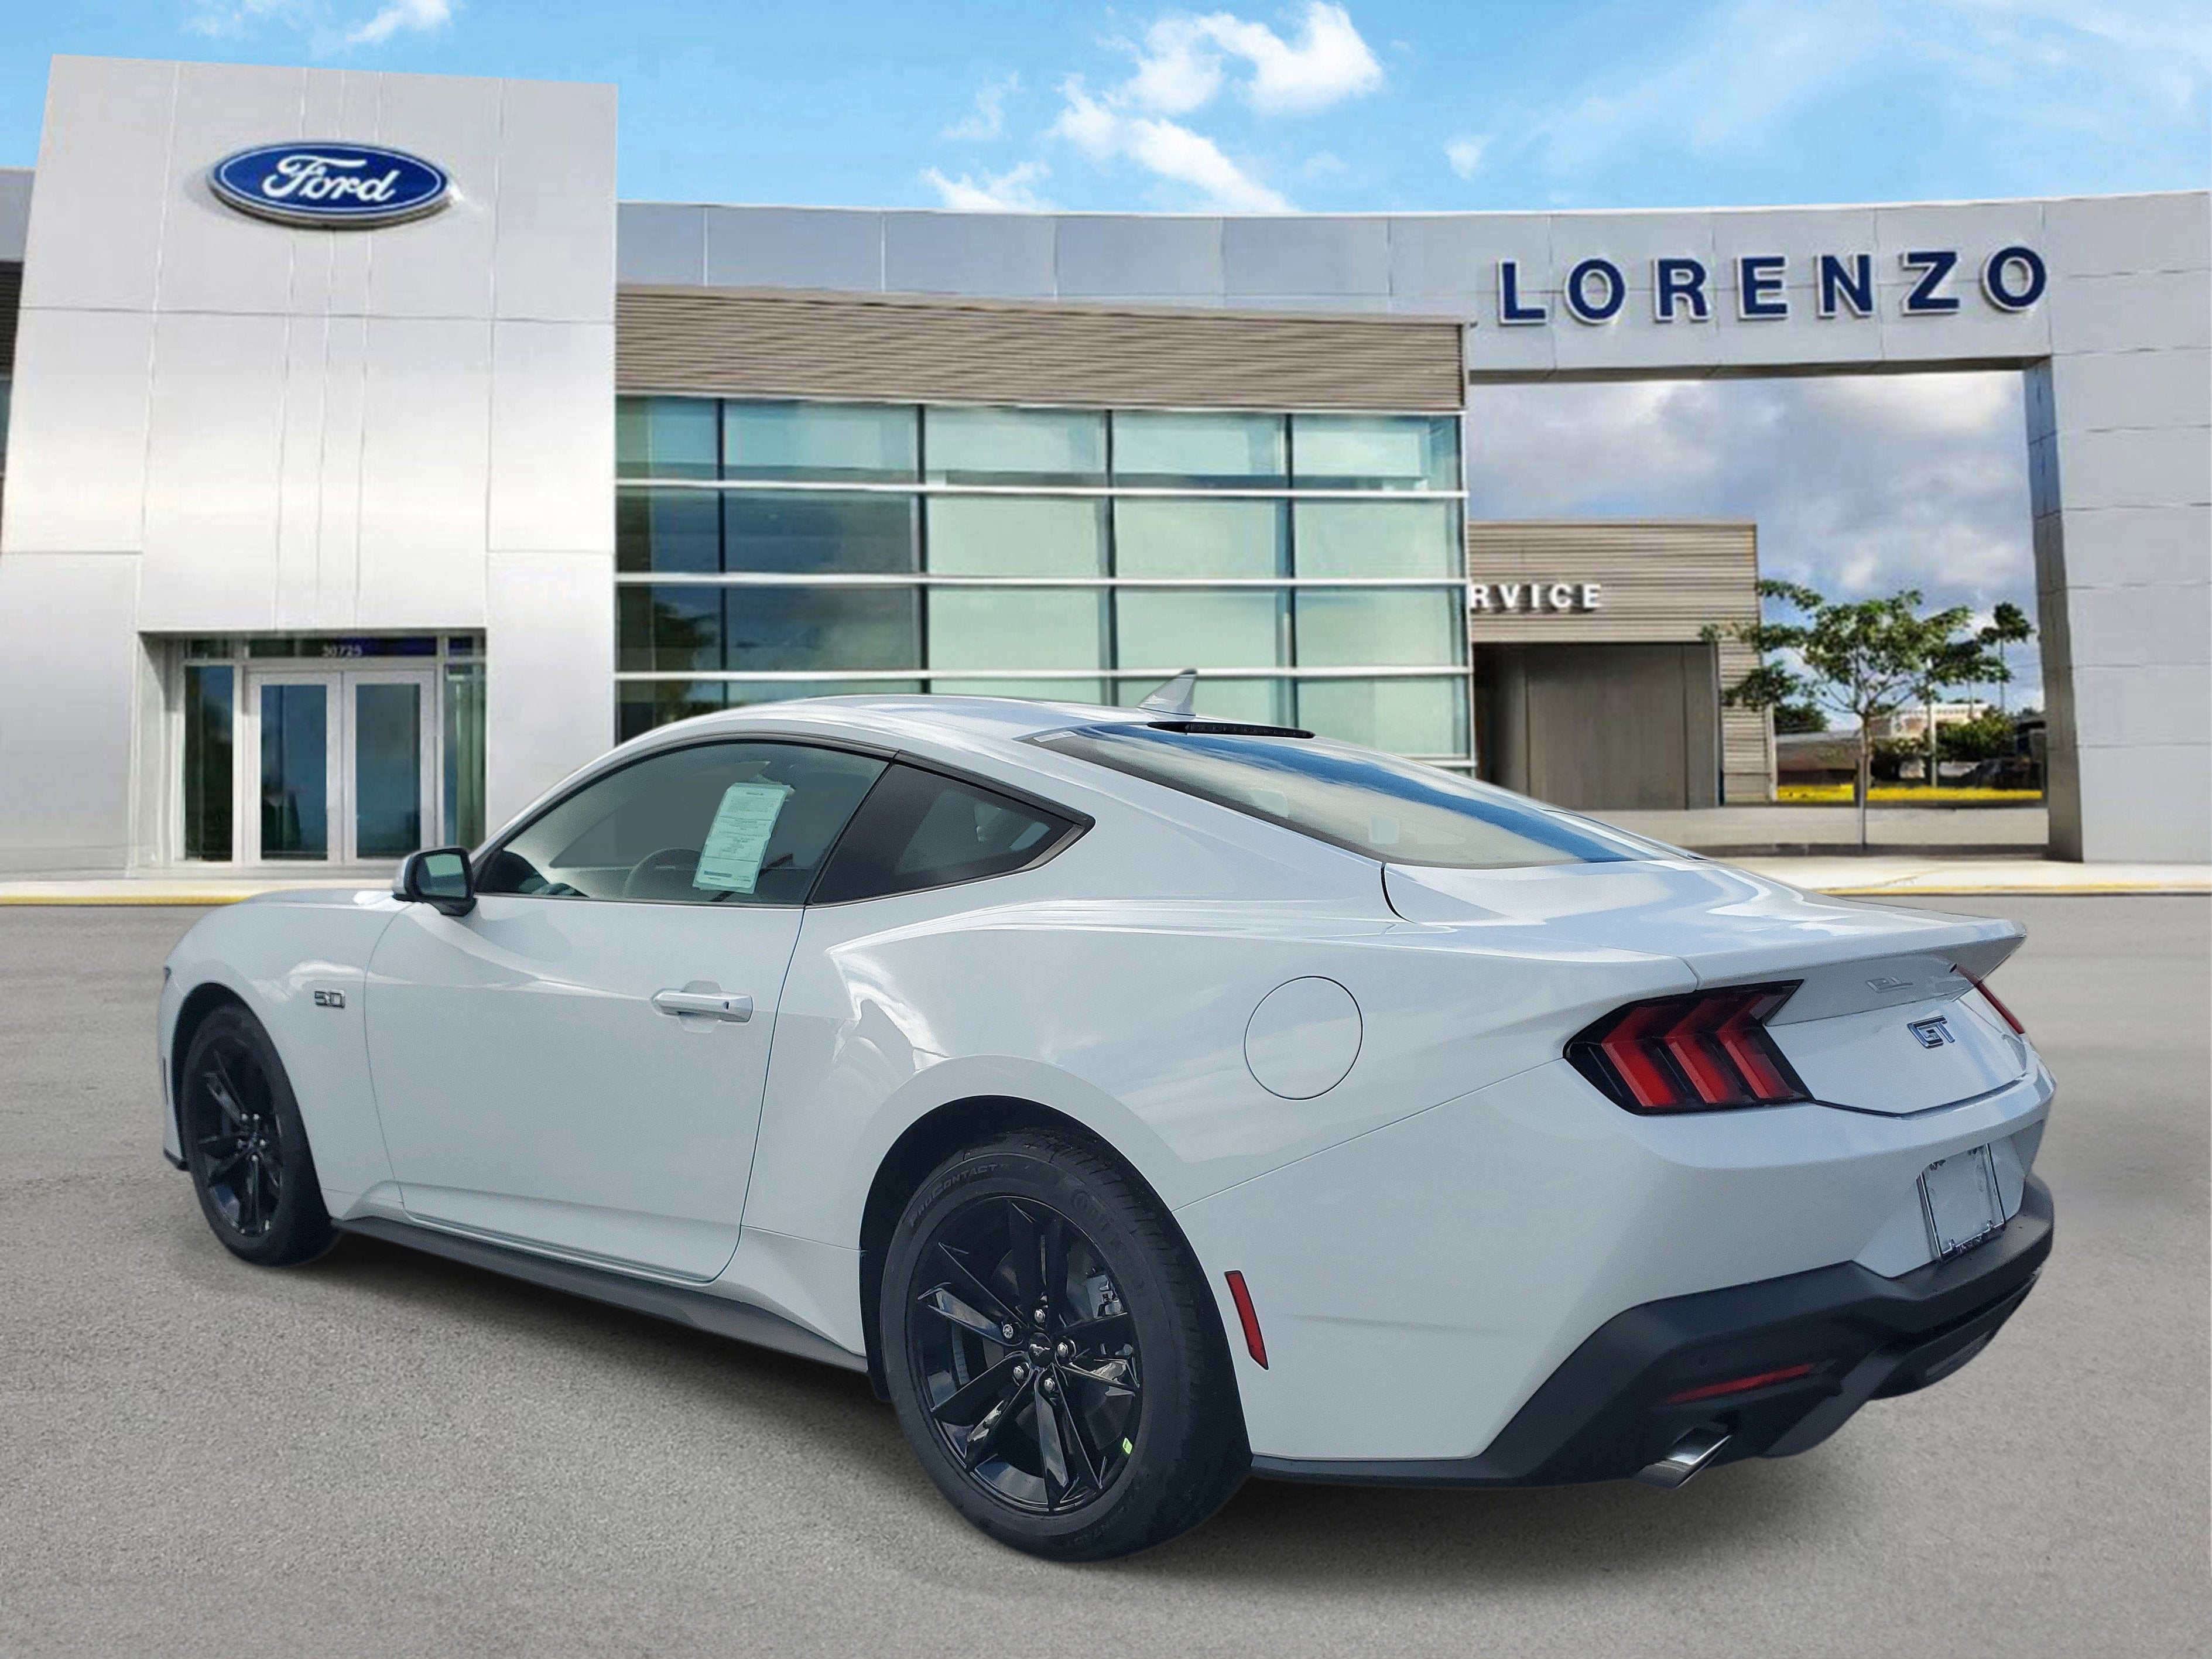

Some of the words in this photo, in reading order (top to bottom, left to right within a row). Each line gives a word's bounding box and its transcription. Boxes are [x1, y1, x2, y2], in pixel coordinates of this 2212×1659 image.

[262, 155, 400, 201] Ford
[1499, 245, 2047, 324] LORENZO
[1906, 1015, 1956, 1049] GT
